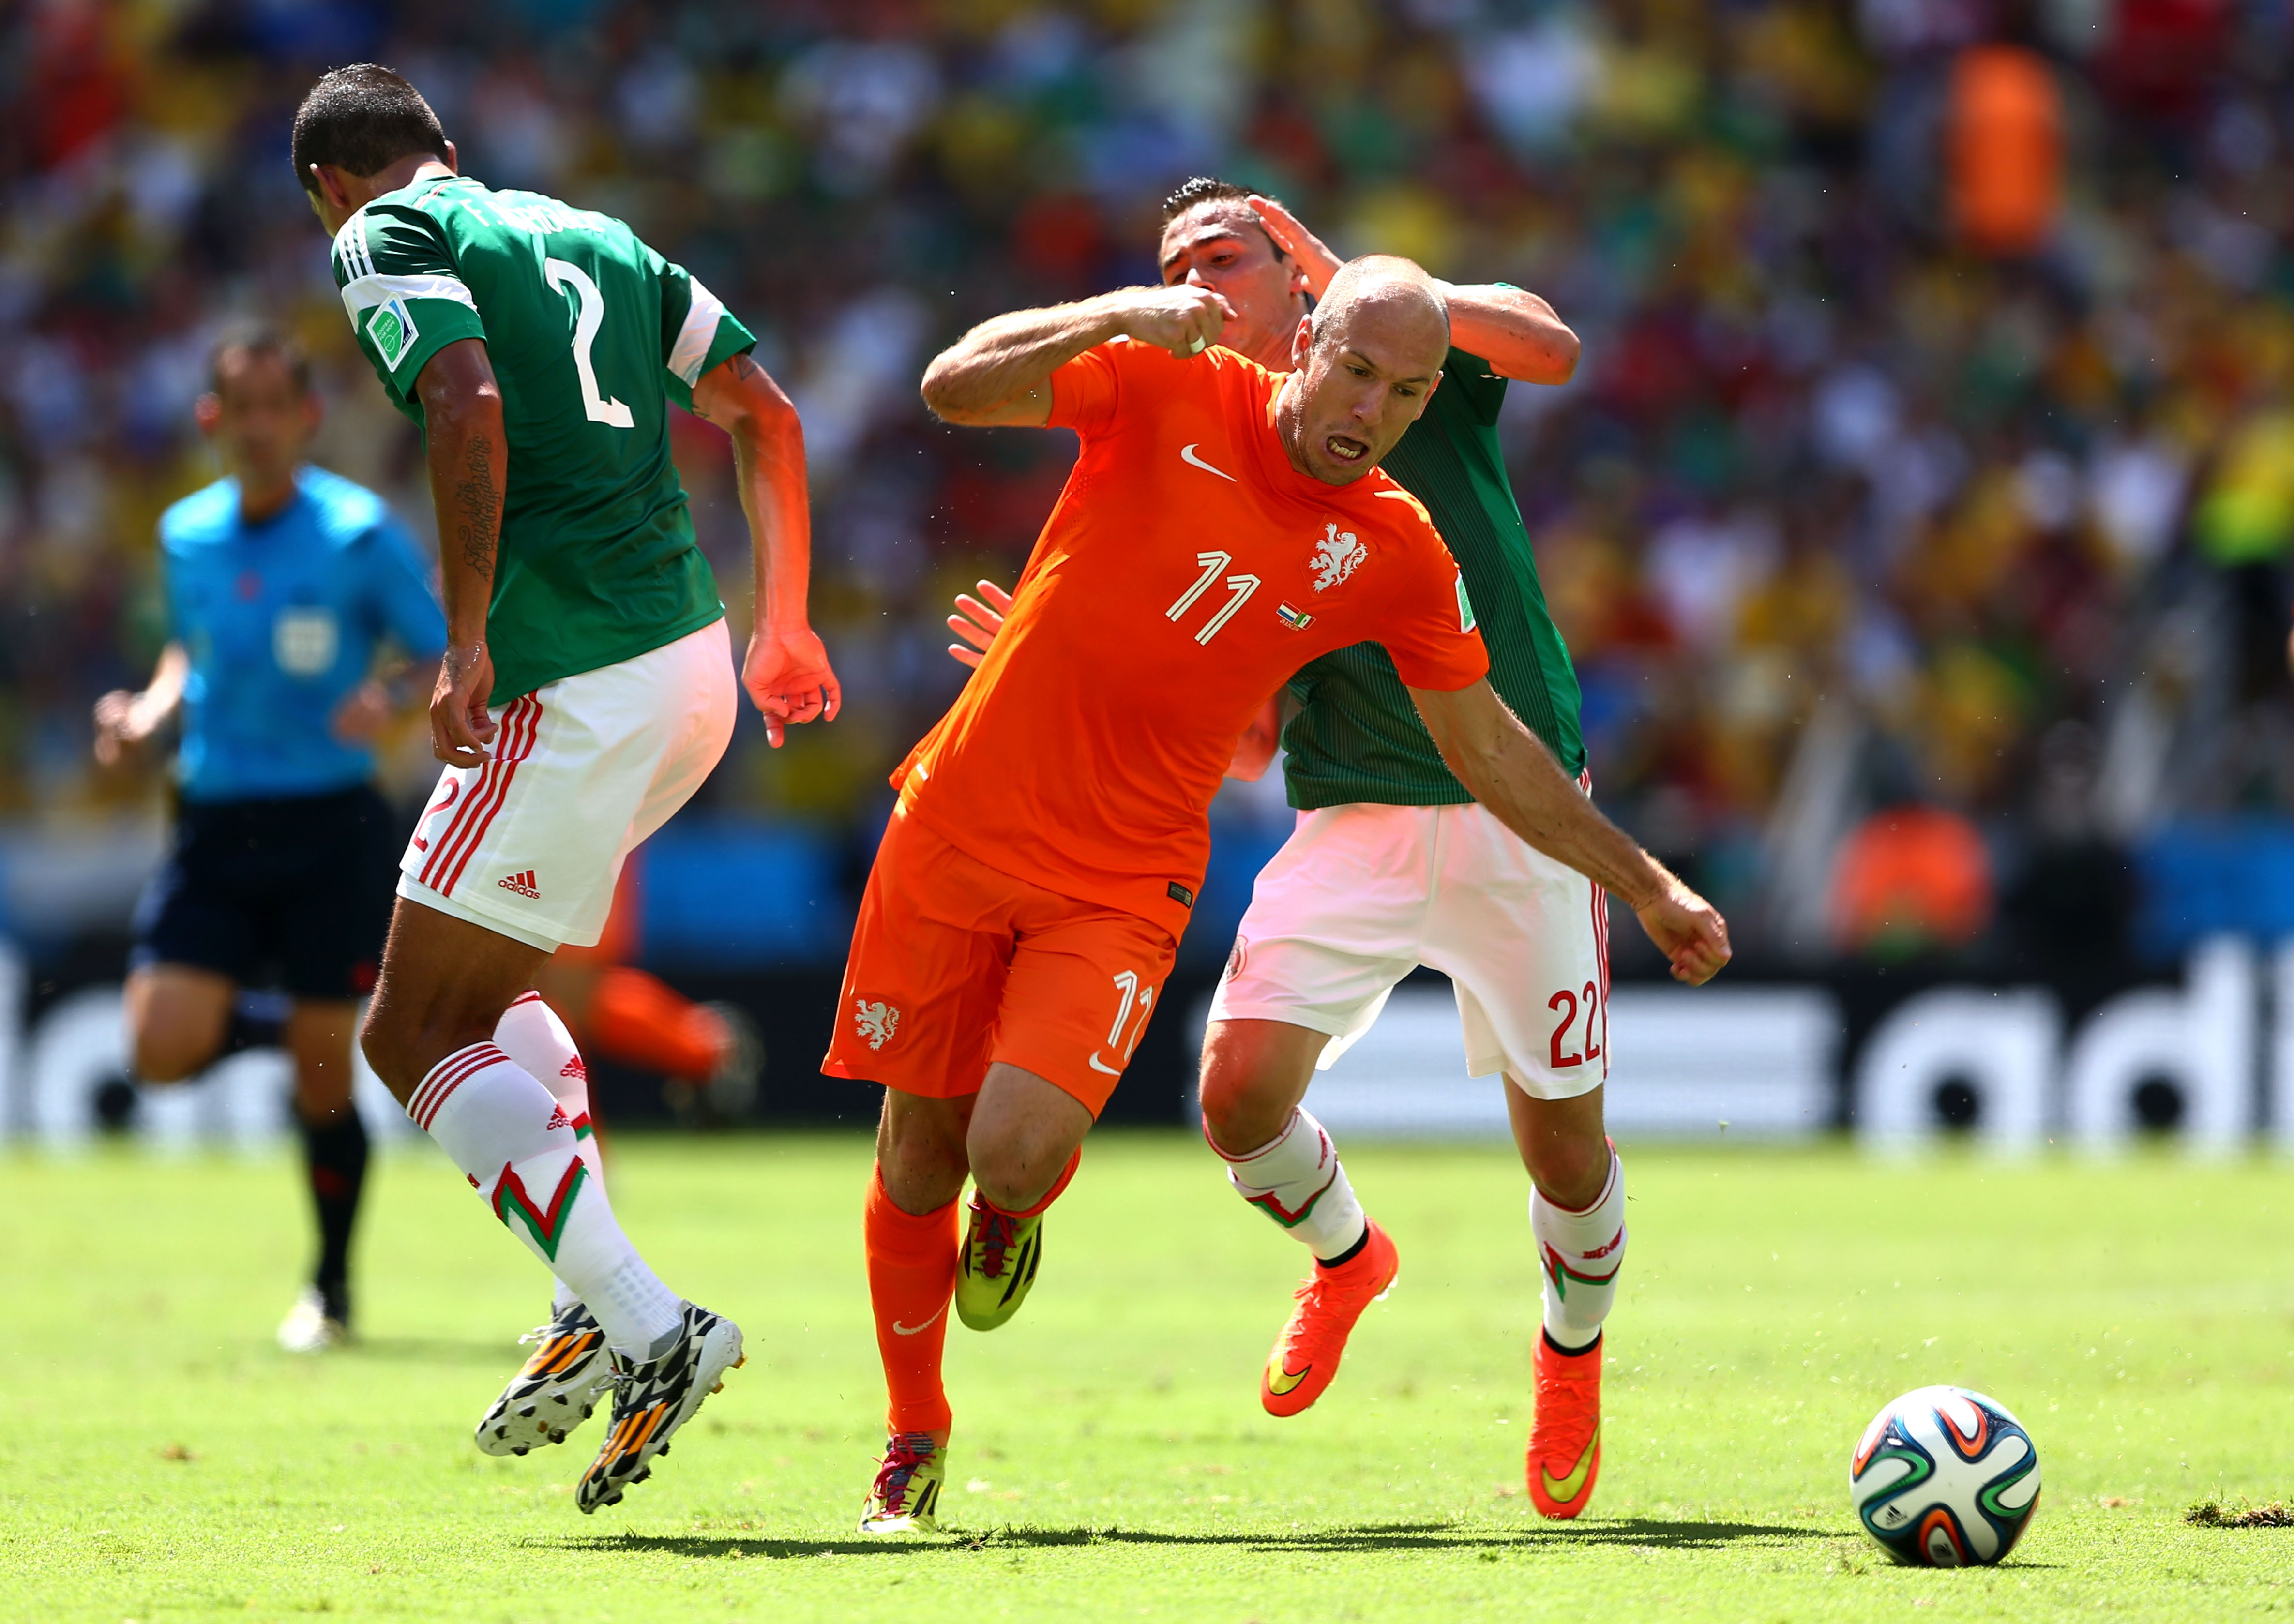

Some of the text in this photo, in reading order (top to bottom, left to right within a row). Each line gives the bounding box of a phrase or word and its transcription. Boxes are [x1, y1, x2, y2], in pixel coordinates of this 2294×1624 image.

[377, 316, 393, 337] FOOTBALL
[386, 320, 395, 333] HOPE
[545, 256, 635, 428] 2
[1165, 550, 1262, 647] 11
[413, 776, 459, 853] 2
[498, 879, 541, 900] adidas
[1107, 969, 1153, 1062] 11
[1548, 980, 1600, 1068] 22
